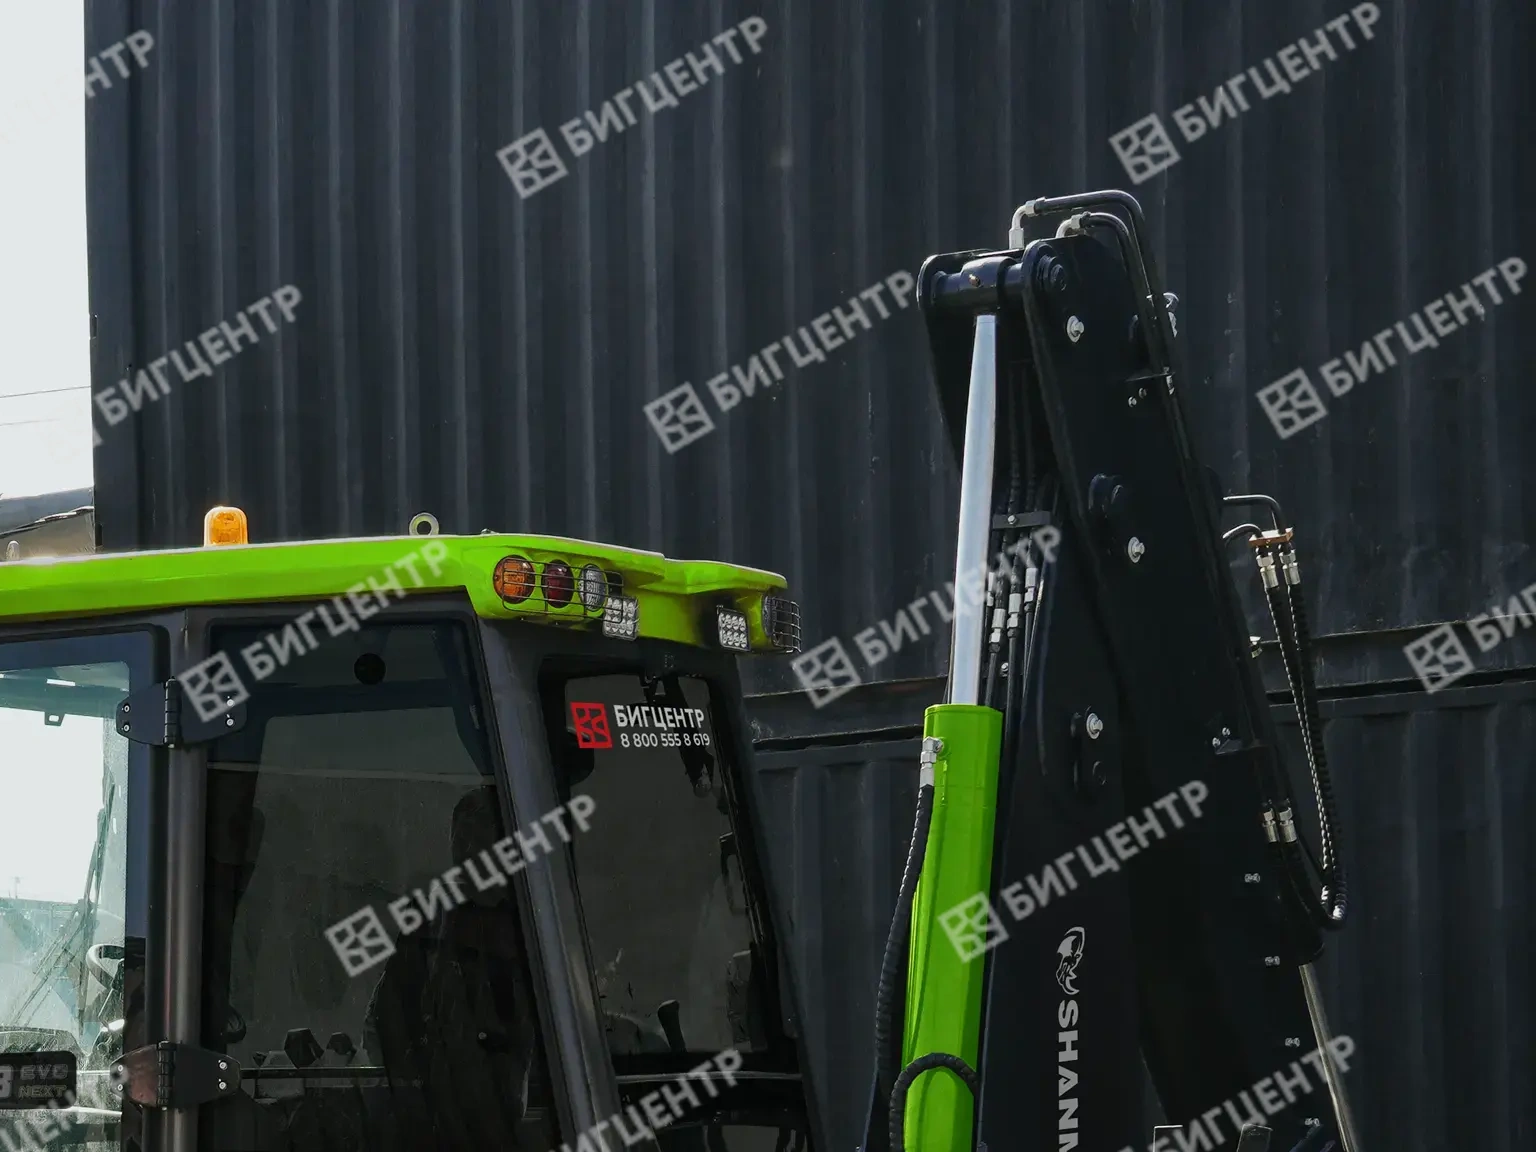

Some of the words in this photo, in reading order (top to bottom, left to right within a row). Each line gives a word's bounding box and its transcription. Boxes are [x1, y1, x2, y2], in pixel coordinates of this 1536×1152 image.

[613, 704, 705, 731] БИГЦЕНТР
[620, 733, 630, 748] 8
[632, 733, 658, 748] 800
[660, 733, 682, 747] 555
[683, 733, 692, 747] 8
[693, 733, 711, 746] 619
[17, 1084, 68, 1099] NEXT
